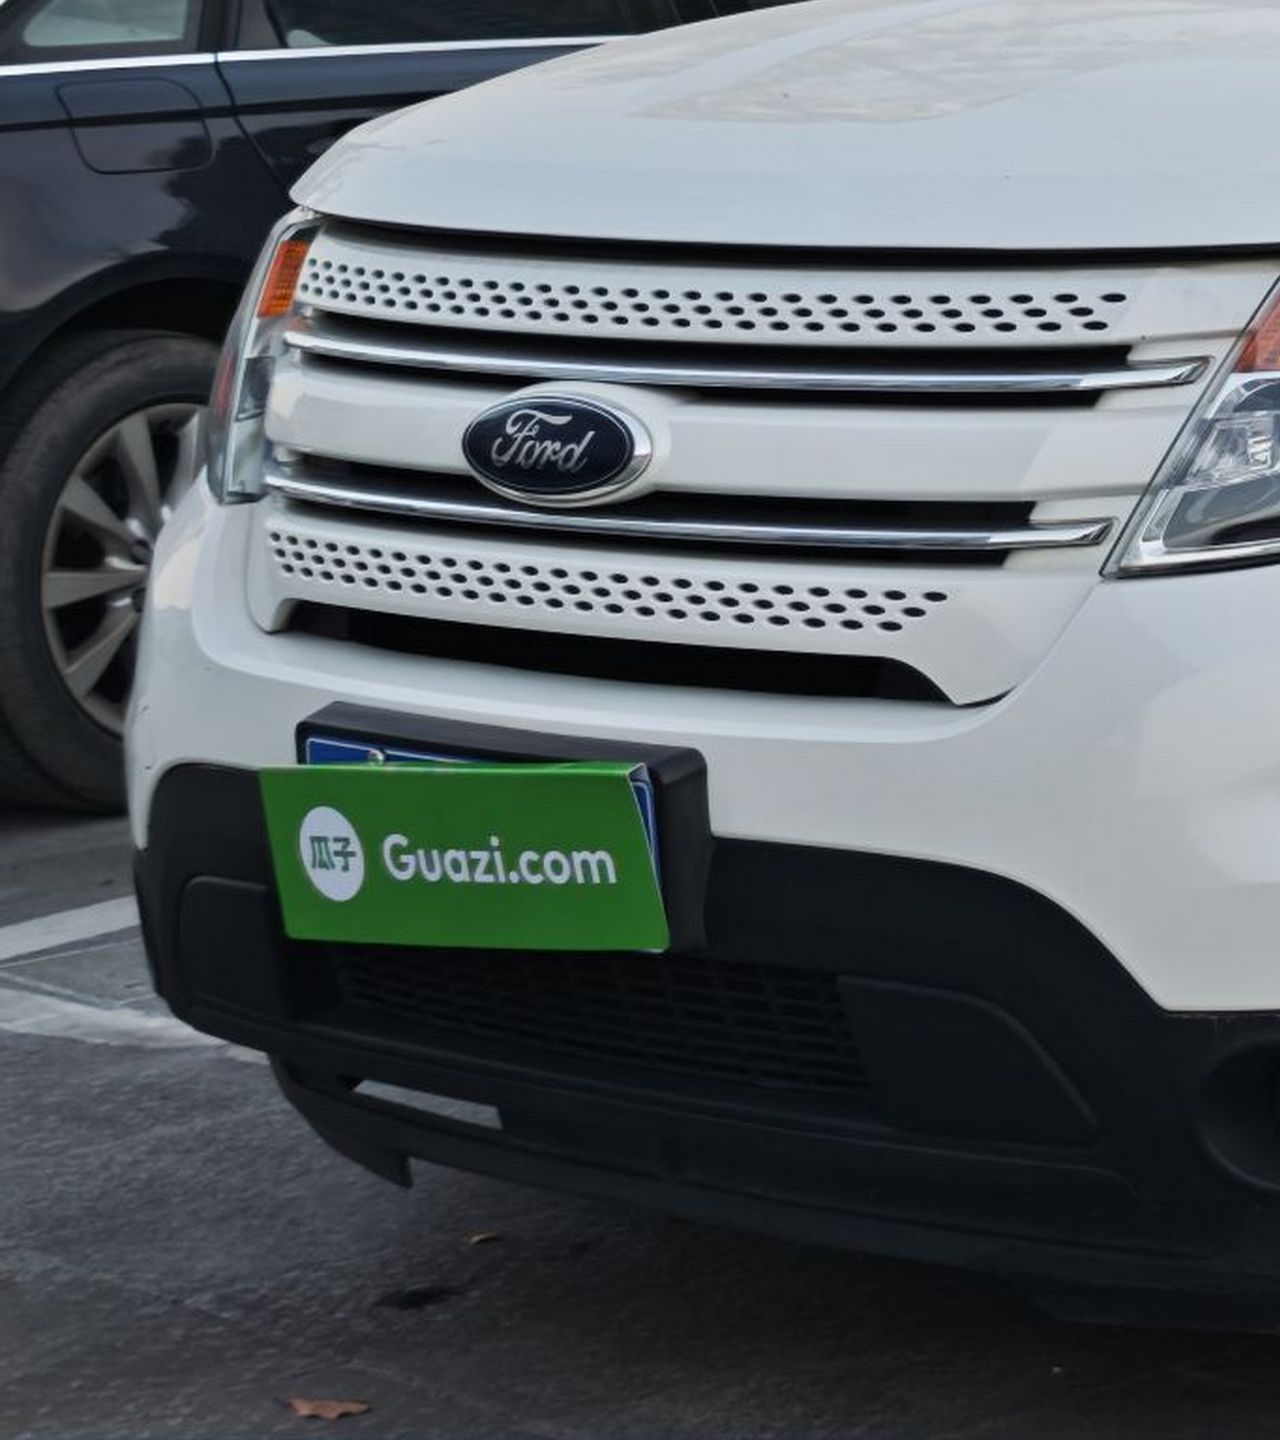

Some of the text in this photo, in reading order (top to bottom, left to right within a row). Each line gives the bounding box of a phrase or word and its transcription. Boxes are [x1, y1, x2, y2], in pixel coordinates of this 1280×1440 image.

[491, 408, 596, 473] Ford
[308, 835, 357, 873] 瓜子
[381, 833, 617, 885] Guazi.com
